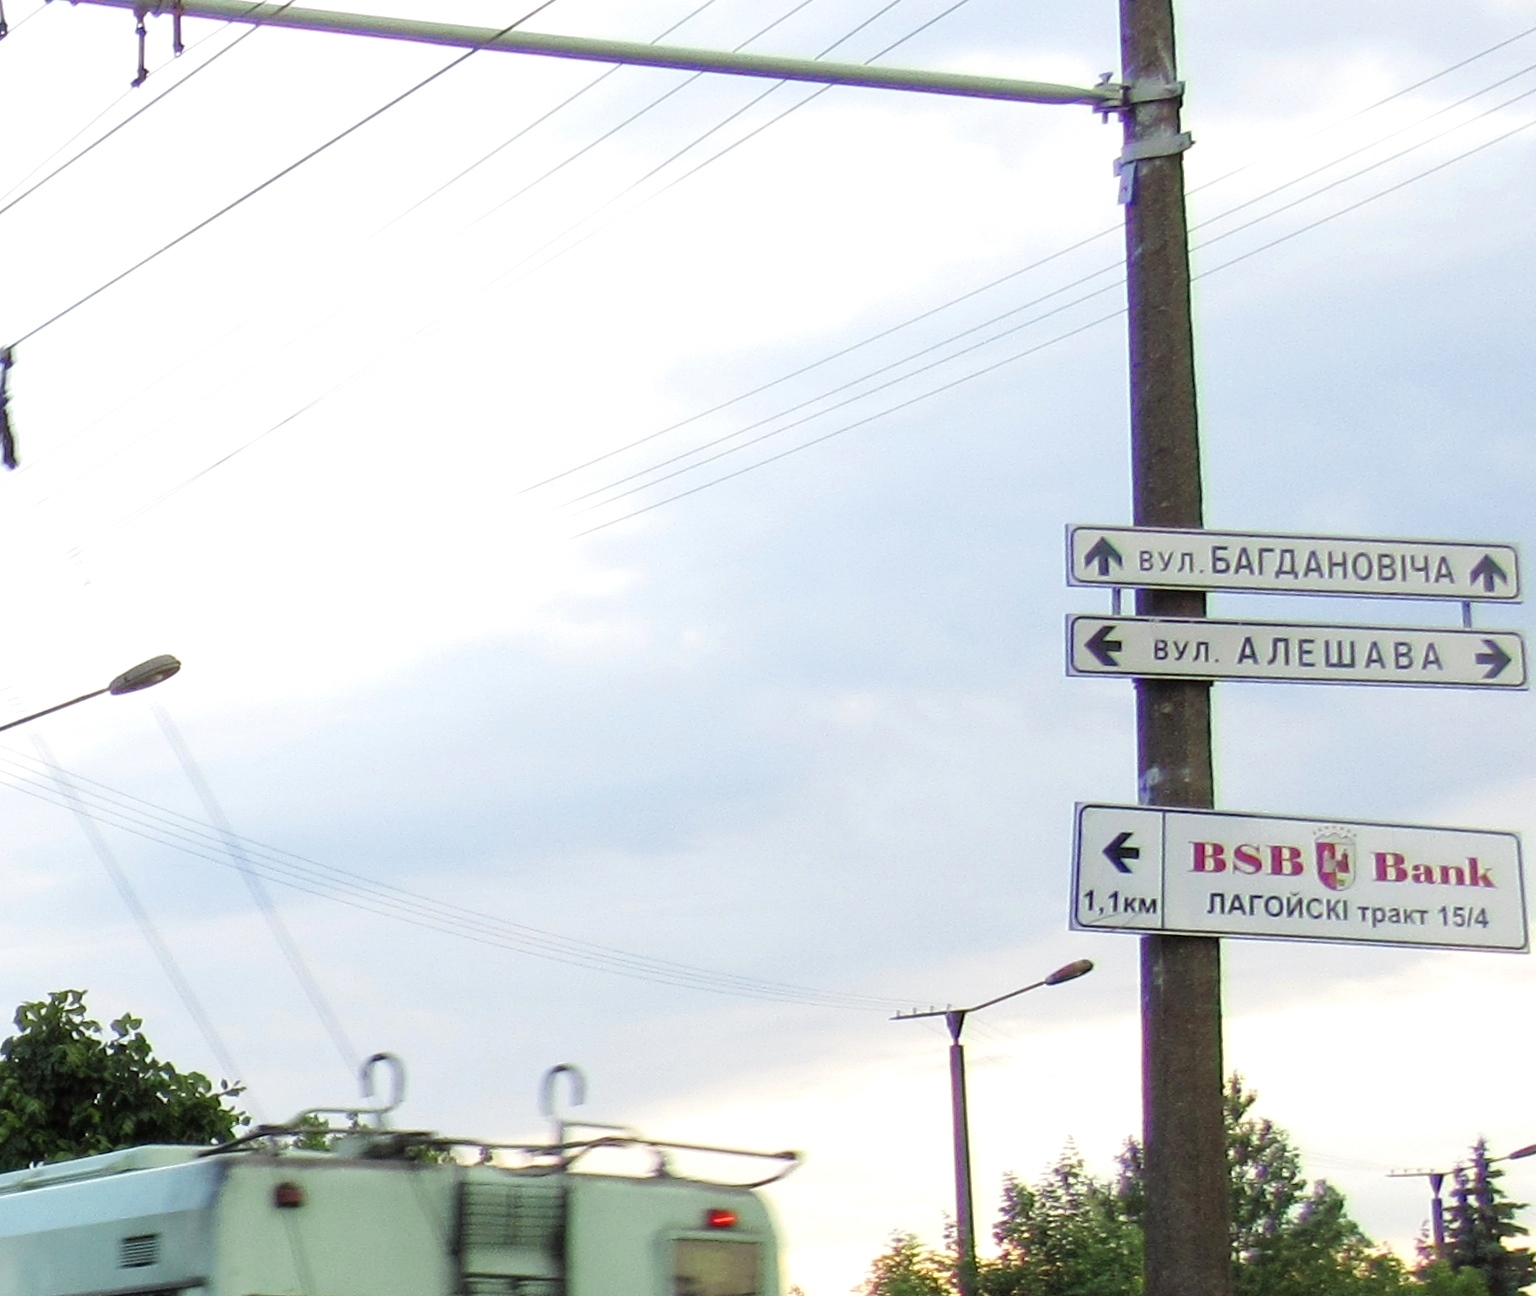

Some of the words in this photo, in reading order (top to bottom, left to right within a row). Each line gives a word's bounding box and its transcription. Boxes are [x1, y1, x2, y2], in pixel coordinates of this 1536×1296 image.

[1210, 545, 1456, 585] БАГДАНОВІЧА
[1236, 636, 1444, 671] АЛЕШАВА
[1187, 841, 1305, 877] BSB
[1372, 851, 1498, 889] Bank
[1206, 890, 1349, 921] ЛАГОЙСКІ
[1357, 905, 1429, 928] тракт
[1437, 905, 1490, 929] 15/4
